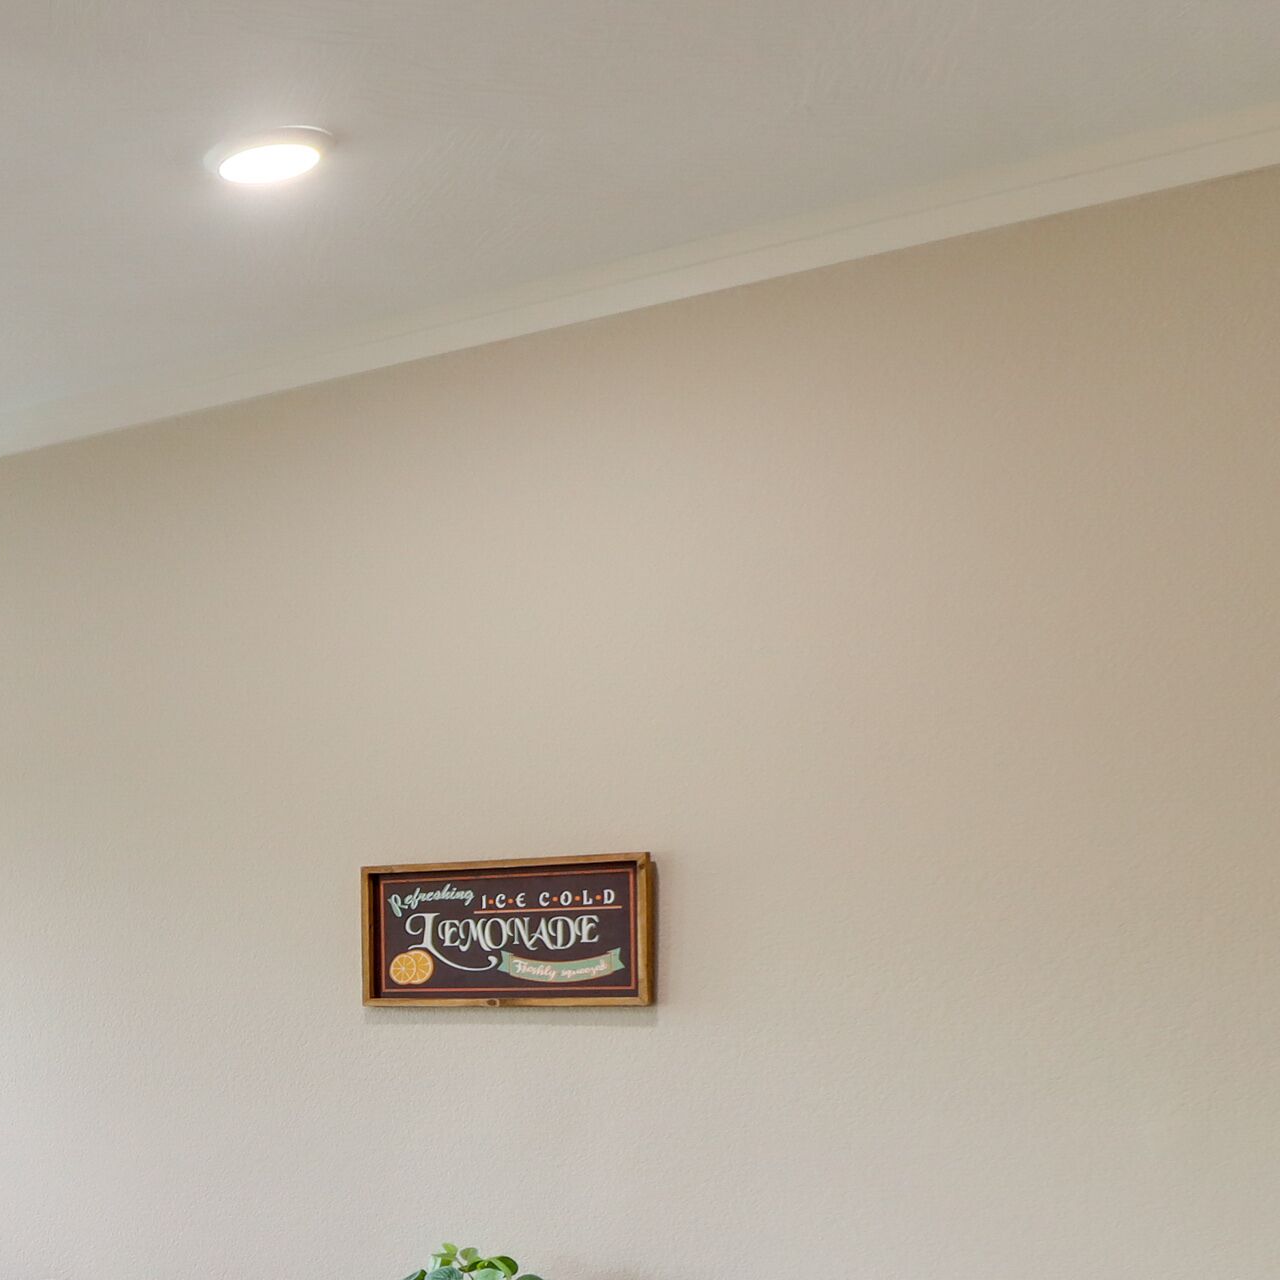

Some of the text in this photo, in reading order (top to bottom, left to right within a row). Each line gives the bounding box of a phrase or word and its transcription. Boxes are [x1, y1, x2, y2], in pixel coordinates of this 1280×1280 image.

[387, 883, 475, 918] Refreshing
[404, 912, 600, 971] LEMONADE
[512, 959, 610, 980] Freshly squeezed
